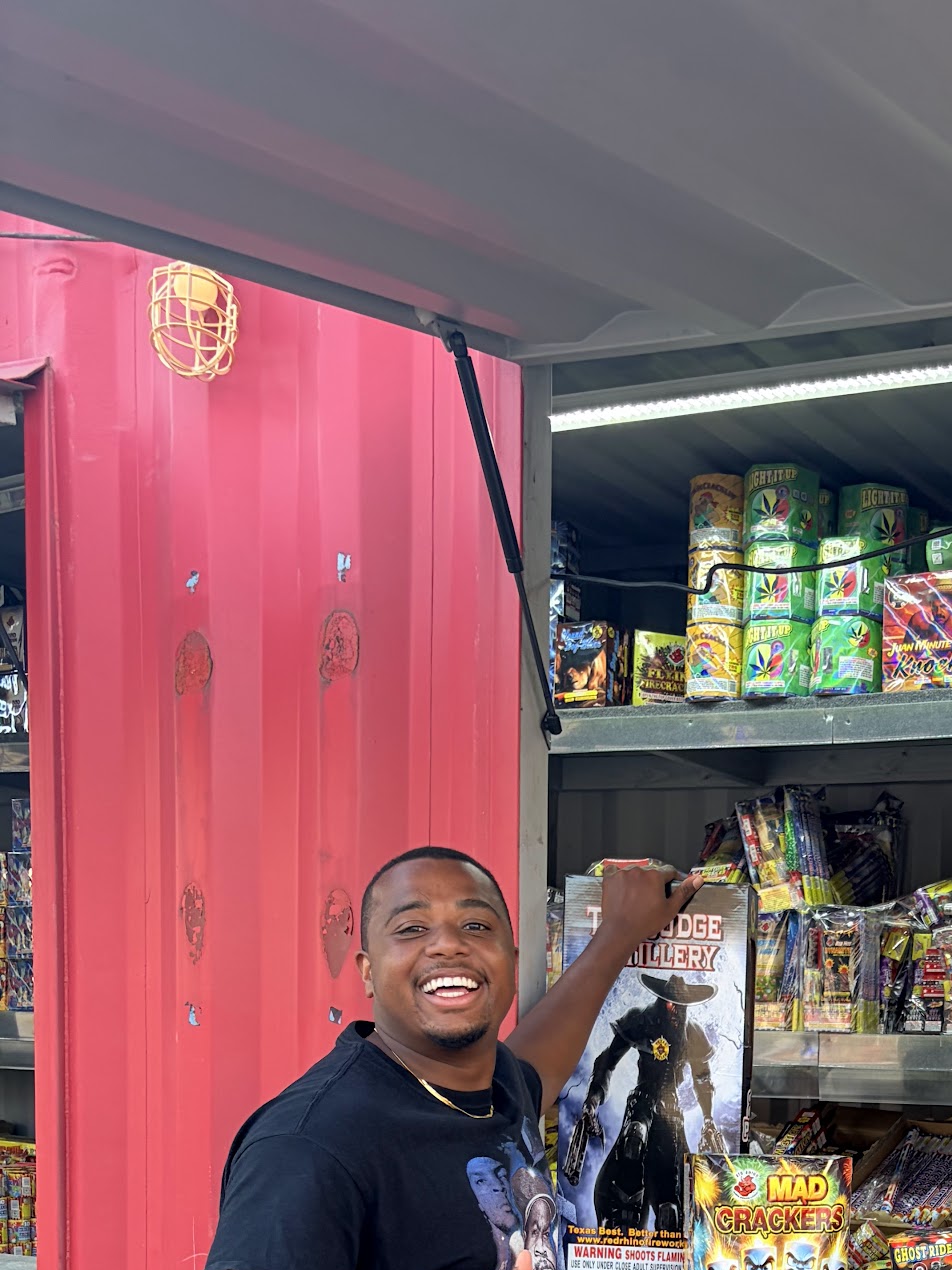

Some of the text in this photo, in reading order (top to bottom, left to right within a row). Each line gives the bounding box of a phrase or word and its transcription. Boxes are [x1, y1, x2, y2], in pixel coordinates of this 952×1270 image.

[786, 468, 798, 480] UP
[862, 489, 888, 509] LIGHT
[779, 625, 792, 637] UP
[887, 638, 951, 656] JUAN MINUTE
[640, 680, 685, 692] FIRECRAC
[626, 942, 720, 972] ILLERY
[767, 1174, 828, 1203] MAD
[714, 1204, 845, 1239] CRACKERS
[568, 1225, 682, 1239] Texas Best. Better than
[574, 1246, 685, 1262] WARNING SHOOTS FLAMIN
[894, 1246, 927, 1263] GHOST
[571, 1260, 580, 1268] USE
[582, 1260, 595, 1269] ONLY
[597, 1261, 613, 1270] UNDER
[615, 1262, 631, 1270] CLOSE
[633, 1263, 648, 1270] ADULT
